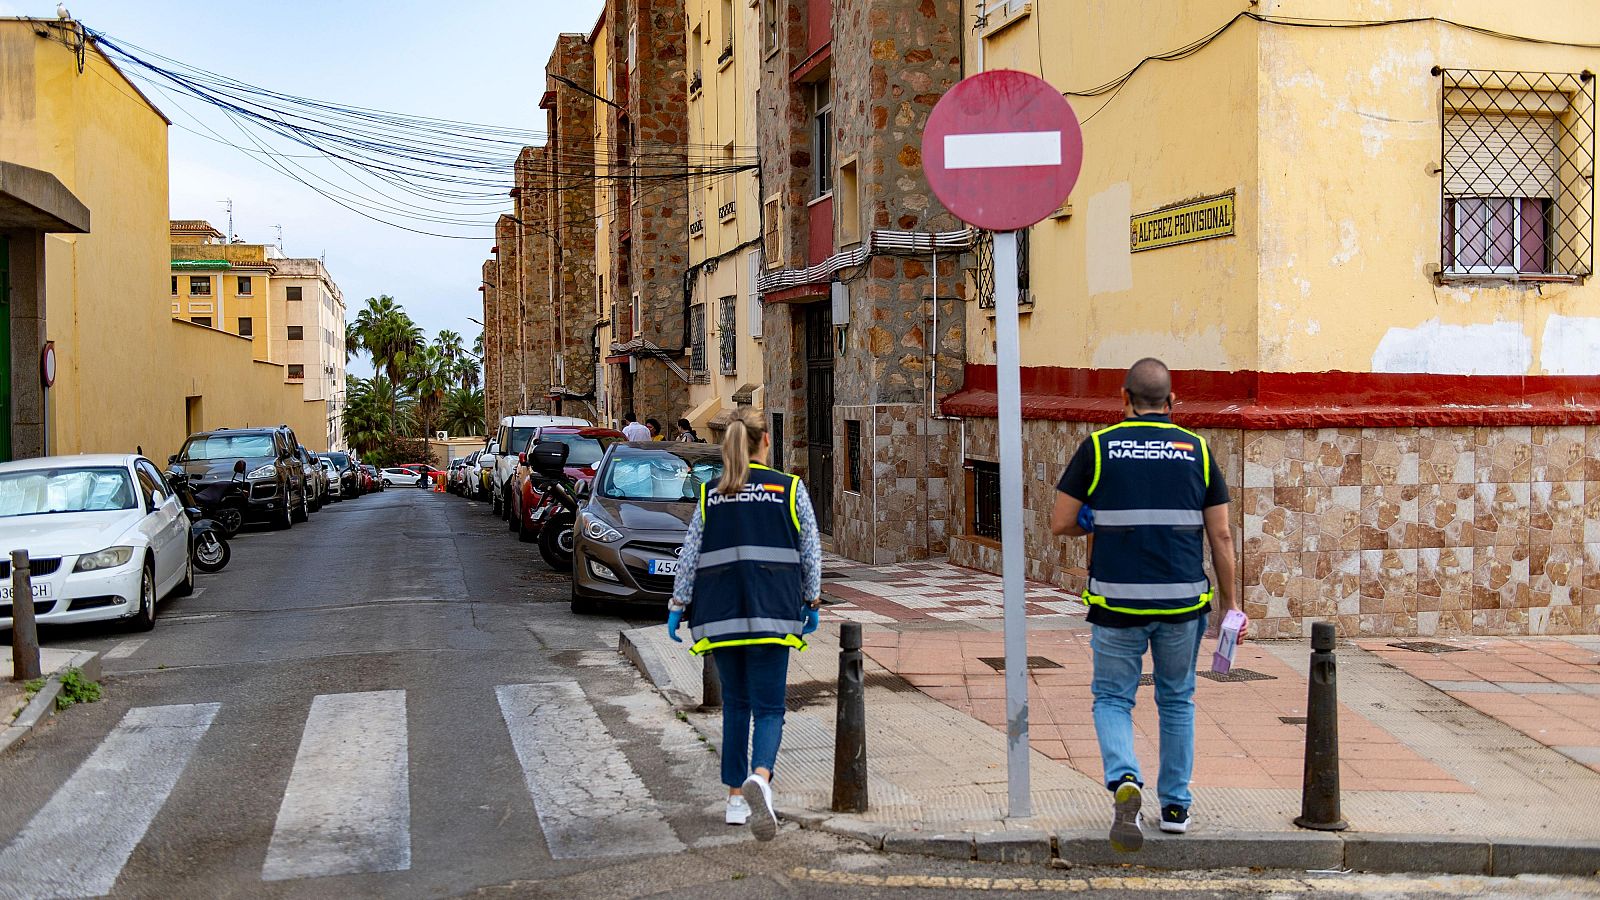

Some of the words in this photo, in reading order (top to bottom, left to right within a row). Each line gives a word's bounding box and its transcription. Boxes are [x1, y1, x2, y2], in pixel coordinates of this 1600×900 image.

[1138, 218, 1172, 242] ALFEREZ
[1174, 205, 1230, 236] PROVISIONAL
[1108, 440, 1175, 450] POLICIA
[1108, 449, 1196, 461] NACIONAL
[707, 492, 784, 507] NACIONAL
